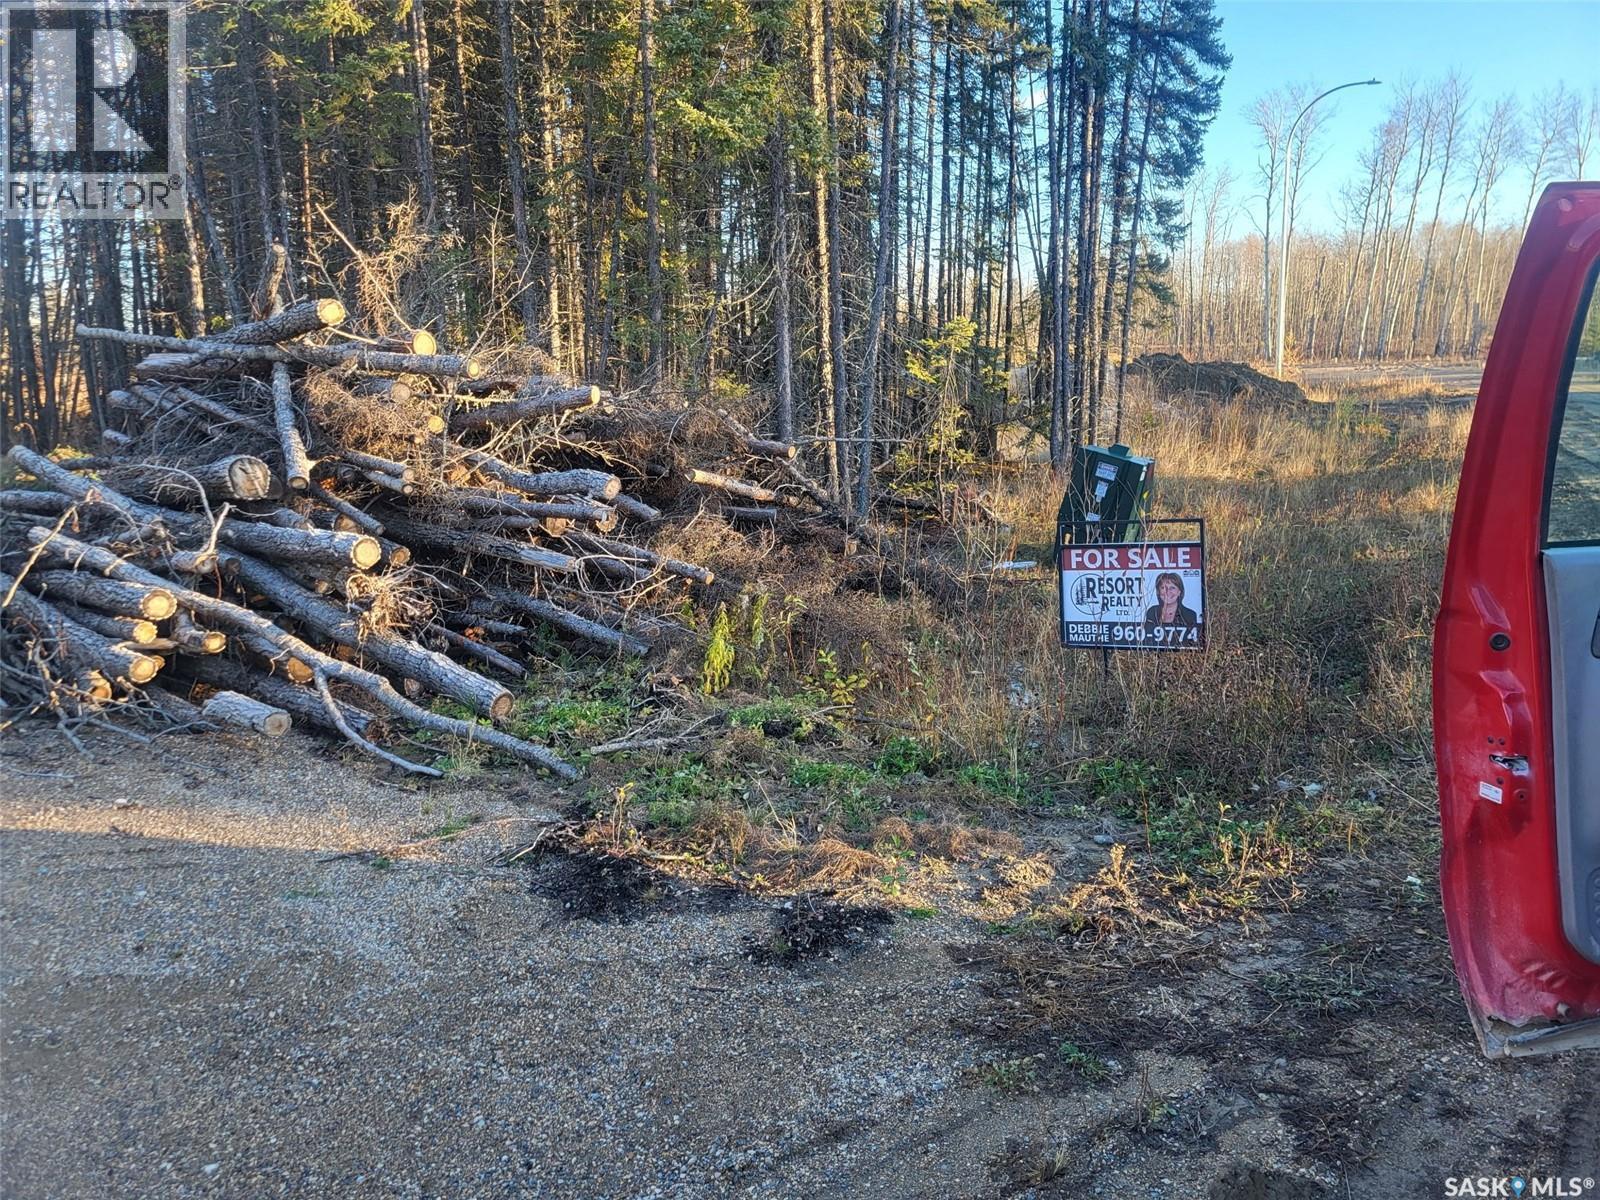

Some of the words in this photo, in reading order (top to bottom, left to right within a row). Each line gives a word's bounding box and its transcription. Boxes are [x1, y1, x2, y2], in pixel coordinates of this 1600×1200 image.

[1070, 549, 1120, 569] FOR
[1127, 547, 1192, 568] SALE
[1085, 577, 1145, 599] RESORT
[1101, 596, 1143, 612] REALTY
[1069, 623, 1110, 634] DEBBIE
[1113, 625, 1198, 642] 960-9774
